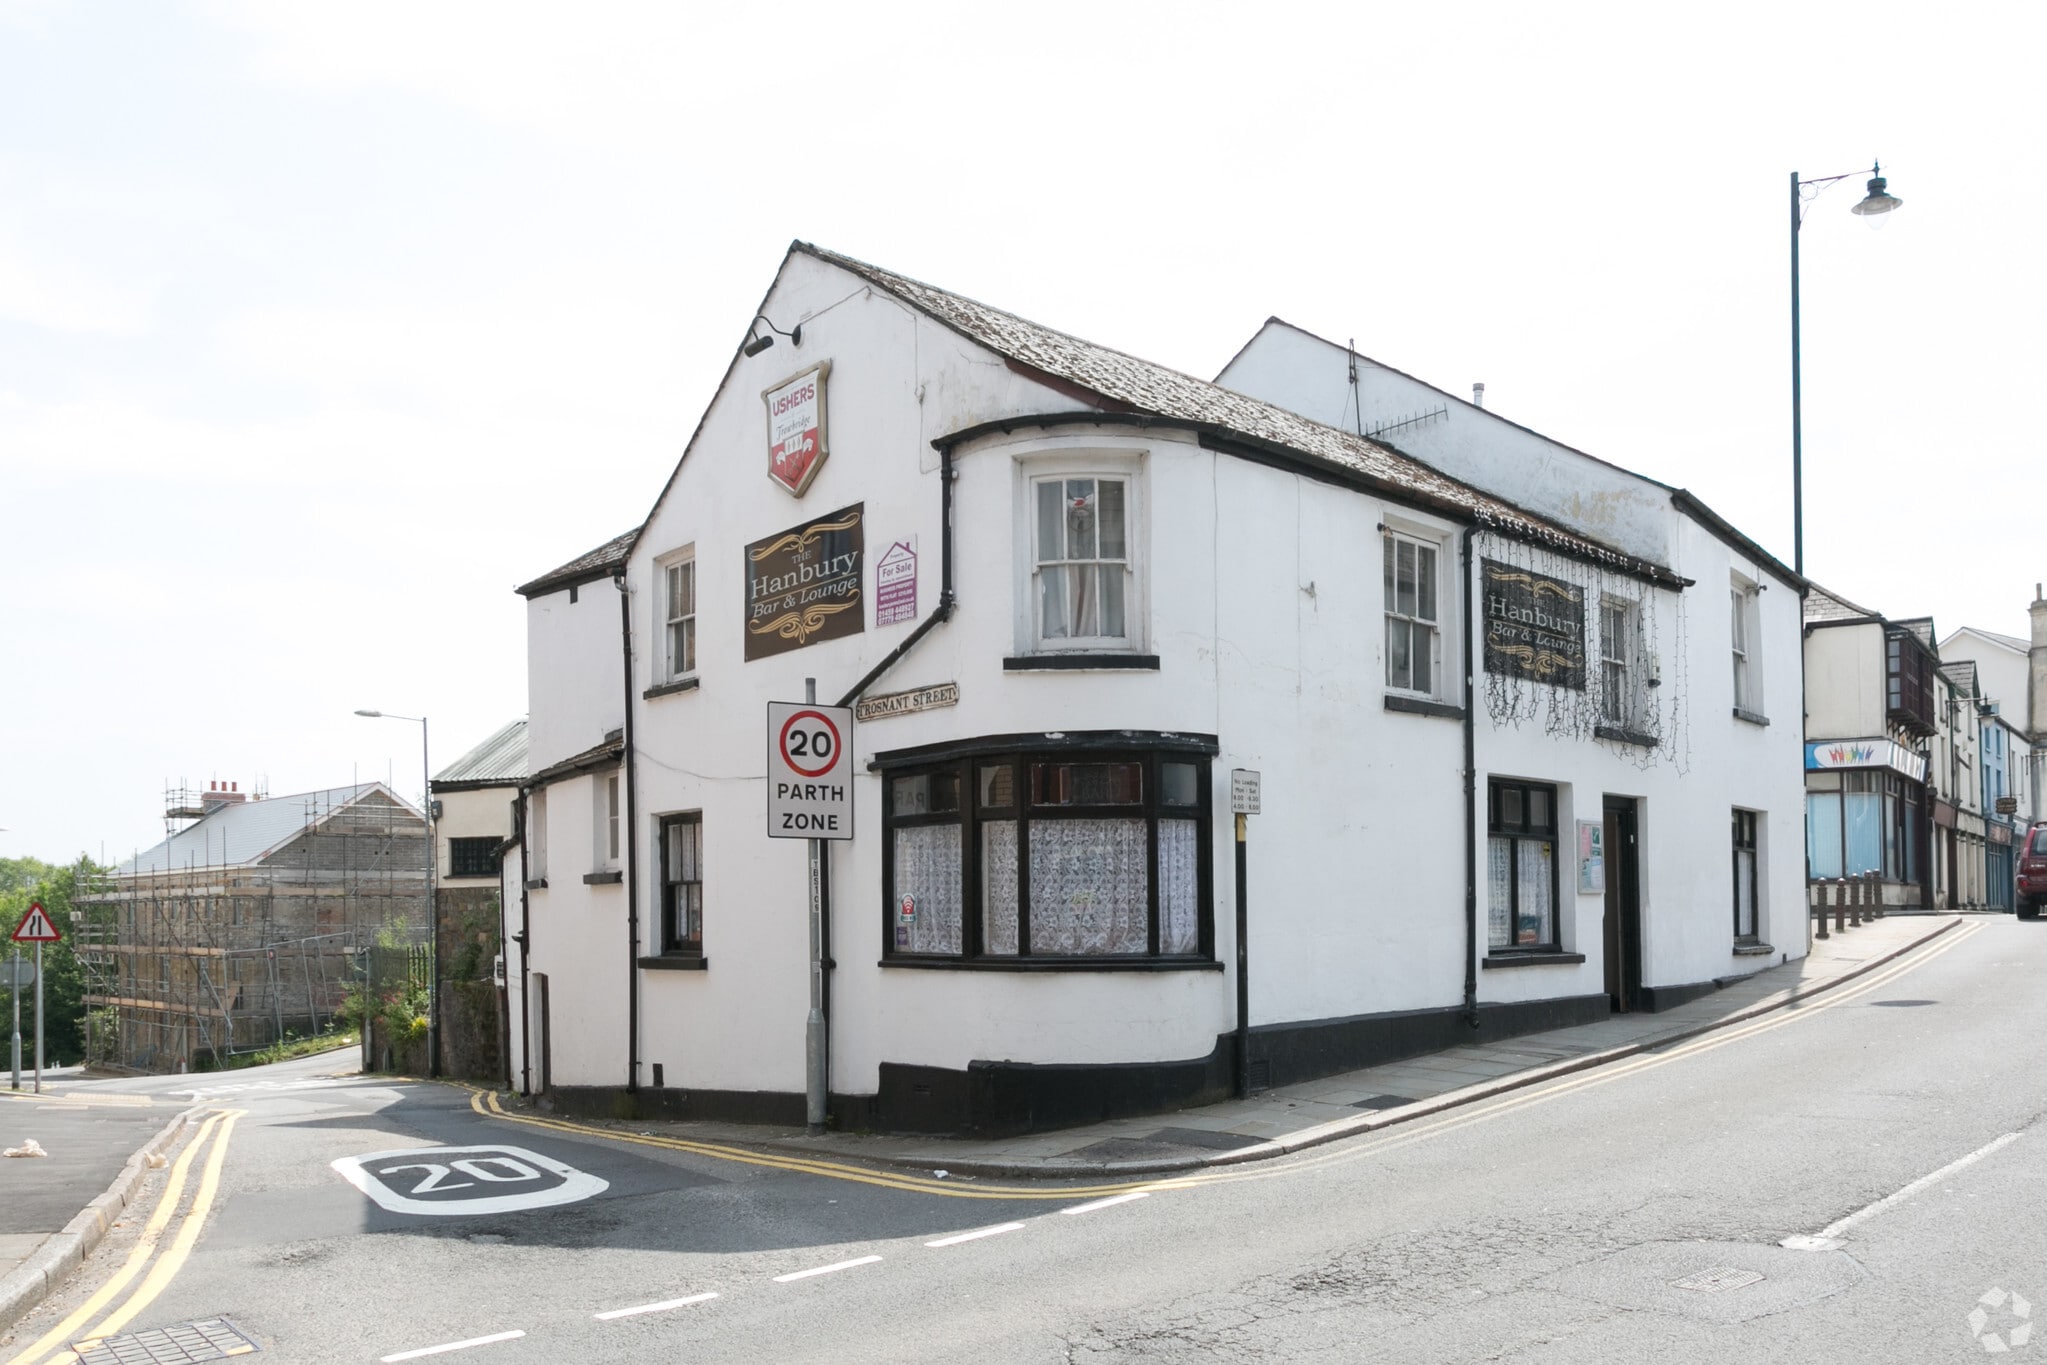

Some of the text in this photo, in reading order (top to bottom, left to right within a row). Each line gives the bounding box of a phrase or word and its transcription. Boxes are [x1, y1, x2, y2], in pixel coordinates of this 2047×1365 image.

[772, 383, 815, 417] USHERS
[791, 550, 812, 564] THE
[882, 562, 912, 578] For Sale
[751, 551, 859, 600] Hanbury
[753, 577, 857, 618] Bar & Lounge
[1488, 595, 1581, 640] Hanbury
[1492, 621, 1582, 655] Bar & Lounge
[859, 687, 955, 717] TROSNANT STREET
[789, 729, 832, 758] 20
[777, 782, 844, 802] PARTH
[782, 812, 839, 831] ZONE
[379, 1157, 542, 1194] 20
